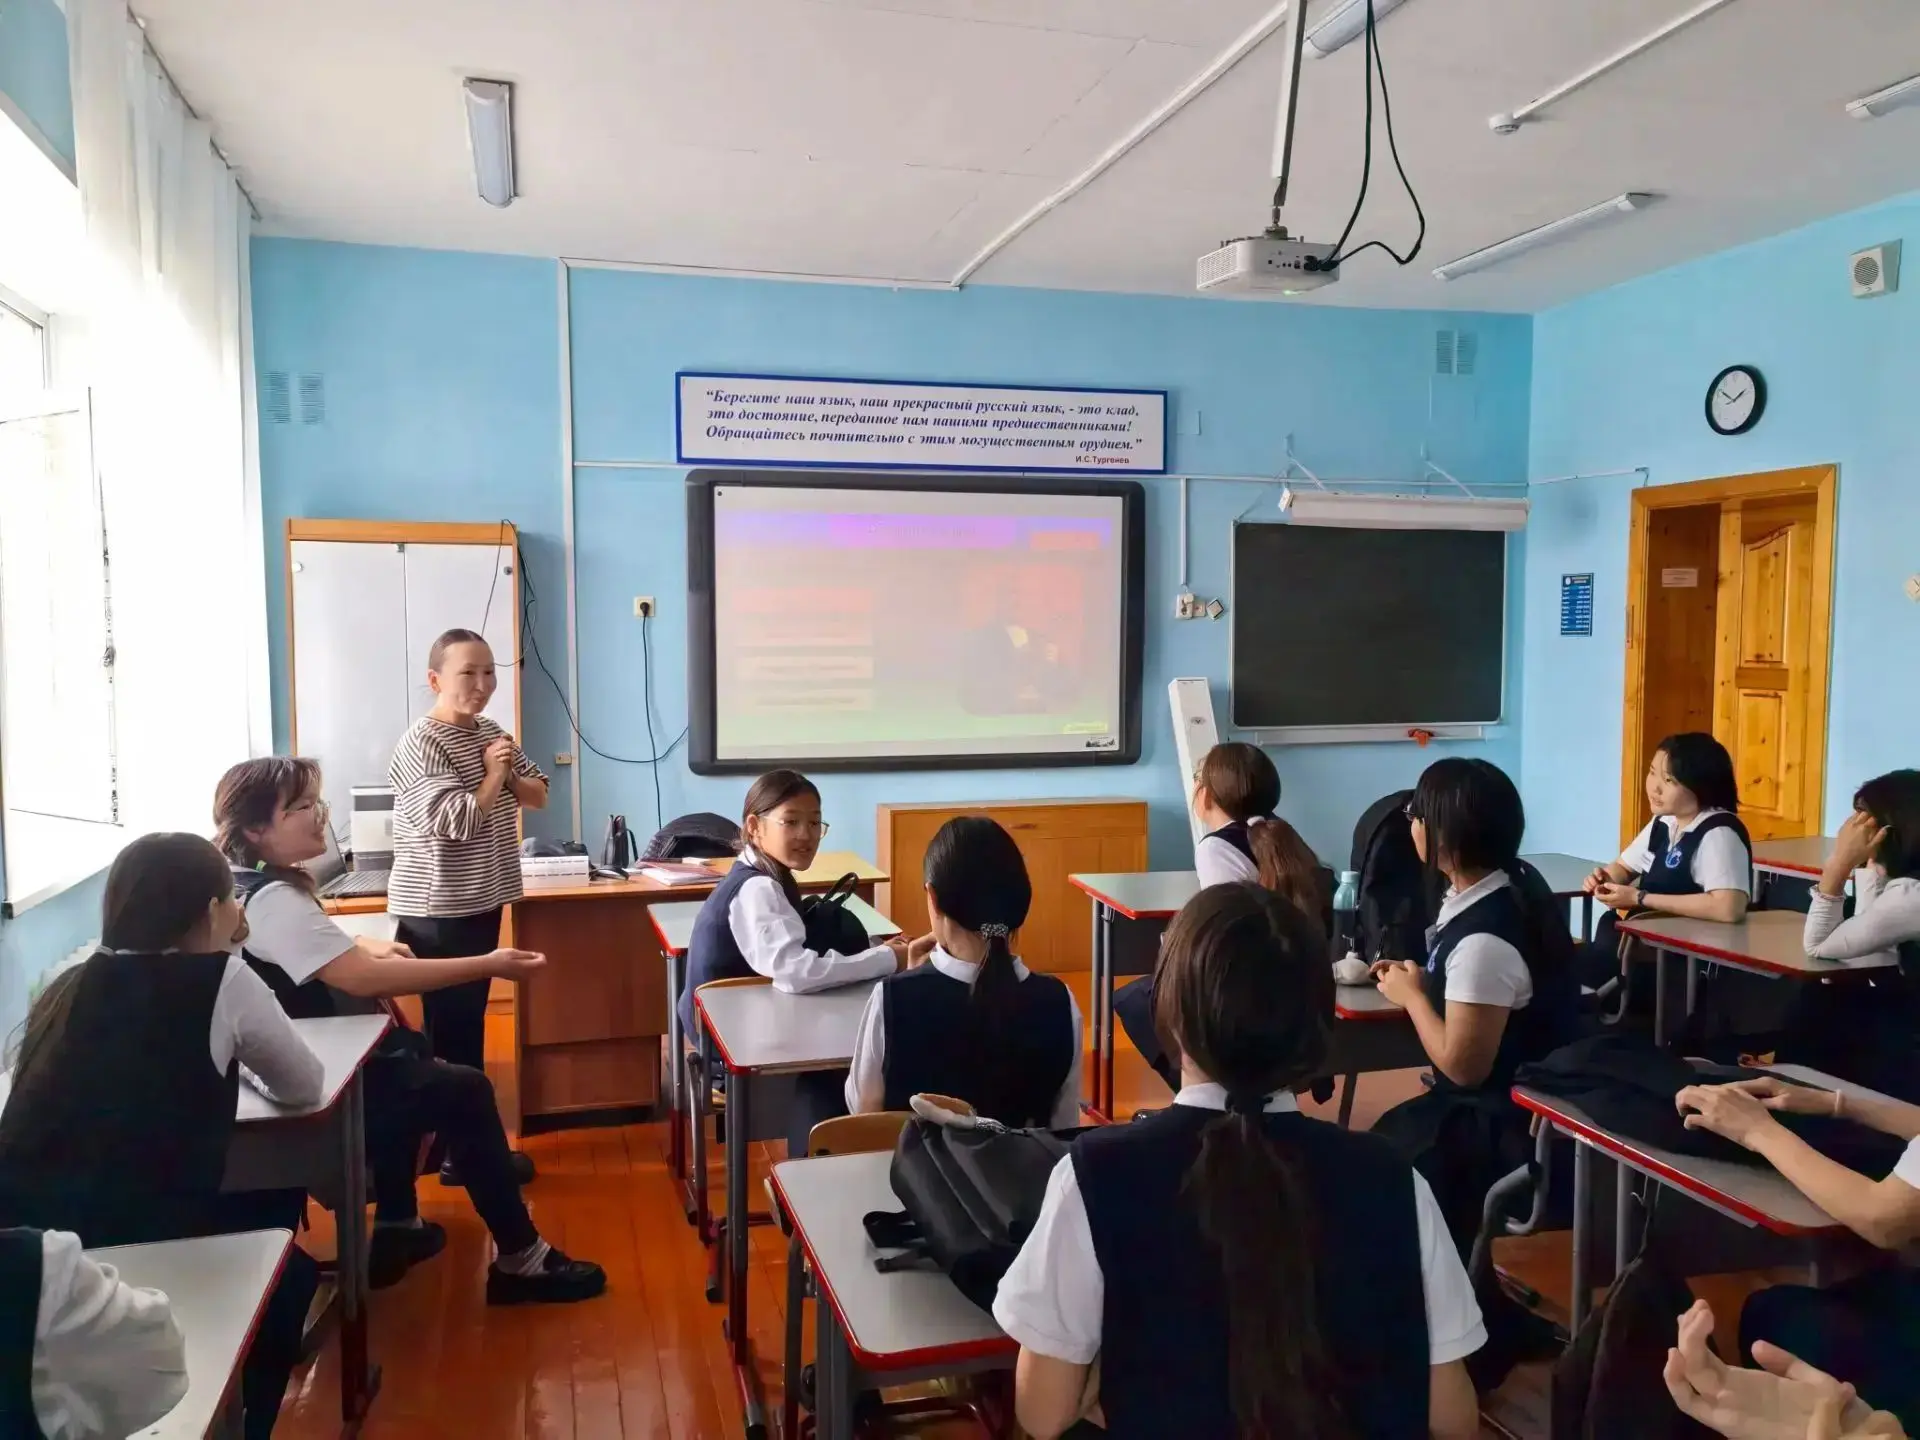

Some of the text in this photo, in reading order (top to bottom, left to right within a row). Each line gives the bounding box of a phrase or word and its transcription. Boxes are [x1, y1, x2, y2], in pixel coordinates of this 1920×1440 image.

[785, 394, 815, 405] наш
[819, 396, 856, 408] язык,
[860, 398, 888, 408] наш
[893, 399, 972, 411] прекрасный
[976, 401, 1028, 414] русский
[1031, 404, 1065, 415] язык,
[1078, 405, 1102, 415] это
[707, 408, 1132, 432] это достояние, переданное нам нашими предшественниками!
[706, 425, 806, 442] Обращайтесь
[810, 432, 904, 444] почтительно
[908, 434, 915, 444] с
[920, 434, 956, 445] этим
[960, 436, 1075, 449] могущественным
